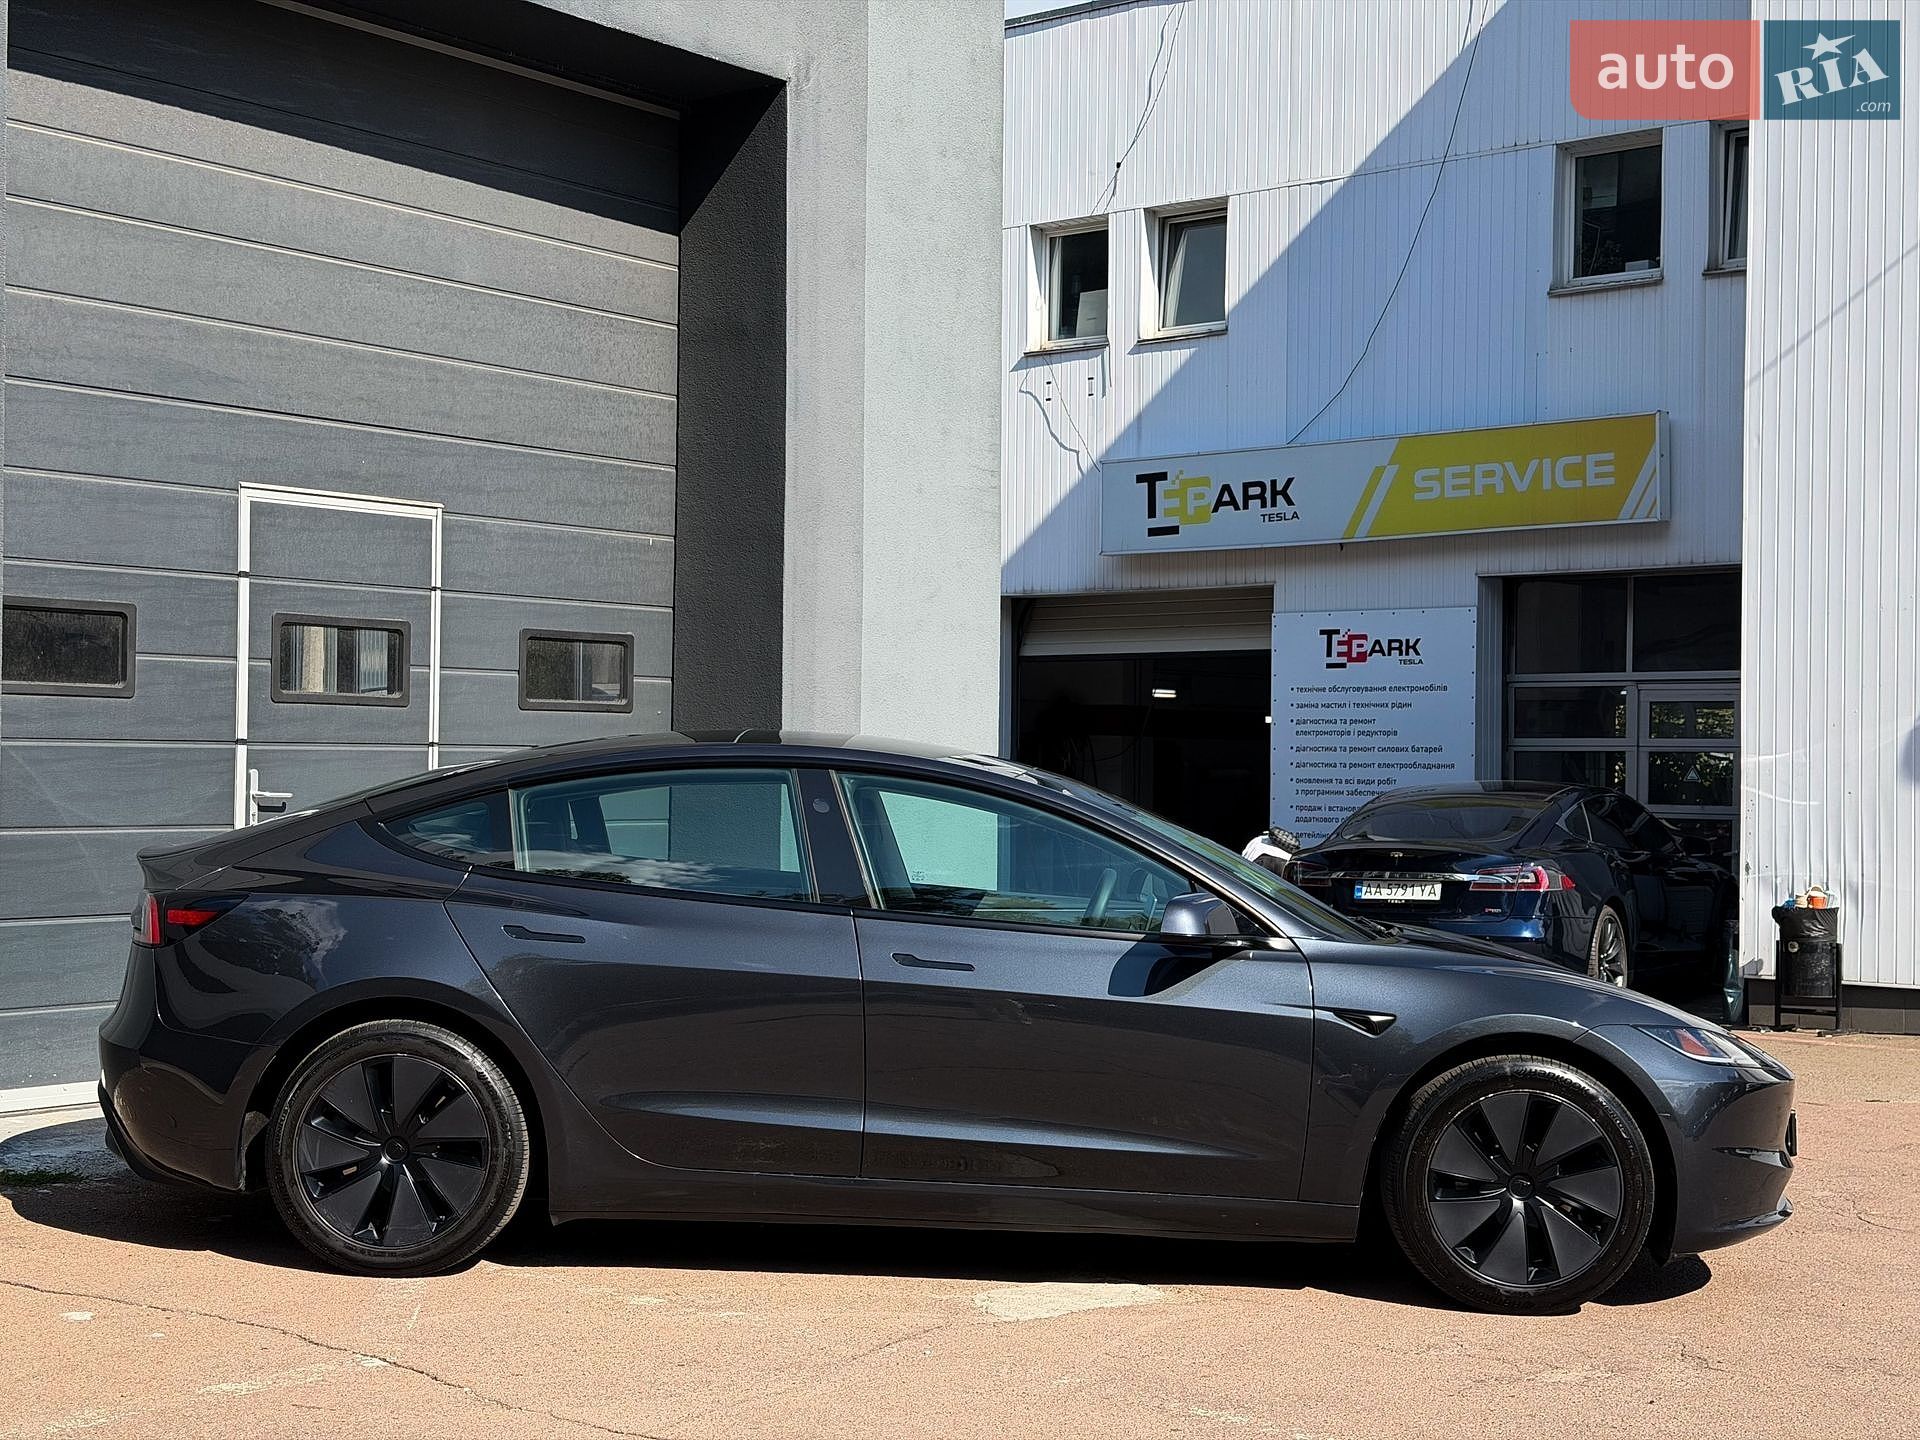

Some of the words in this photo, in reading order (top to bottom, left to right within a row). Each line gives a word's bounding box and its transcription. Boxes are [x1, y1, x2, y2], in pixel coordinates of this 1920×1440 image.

[1412, 451, 1616, 502] SERVICE
[1260, 510, 1300, 524] TESLA
[1328, 684, 1387, 695] обслуговування
[1388, 683, 1448, 694] електромобілів
[1295, 701, 1320, 709] заміна
[1352, 701, 1389, 709] технічних
[1390, 701, 1413, 711] рідин
[1295, 717, 1338, 726] діагностика
[1349, 718, 1376, 727] ремонт
[1357, 728, 1398, 738] редукторів
[1295, 744, 1338, 754] діагностика
[1349, 746, 1376, 755] ремонт
[1411, 745, 1443, 755] батарей
[1295, 761, 1338, 770] діагностика
[1349, 762, 1376, 771] ремонт
[1377, 761, 1455, 771] електрообладнання
[1345, 777, 1355, 785] всі
[1356, 778, 1376, 787] види
[1377, 777, 1397, 788] робіт
[1301, 789, 1345, 798] програмним
[1295, 804, 1323, 812] продаж
[1295, 816, 1340, 824] додаткового
[1364, 883, 1383, 897] AA
[1386, 882, 1416, 897] 5791
[1420, 882, 1437, 897] YA
